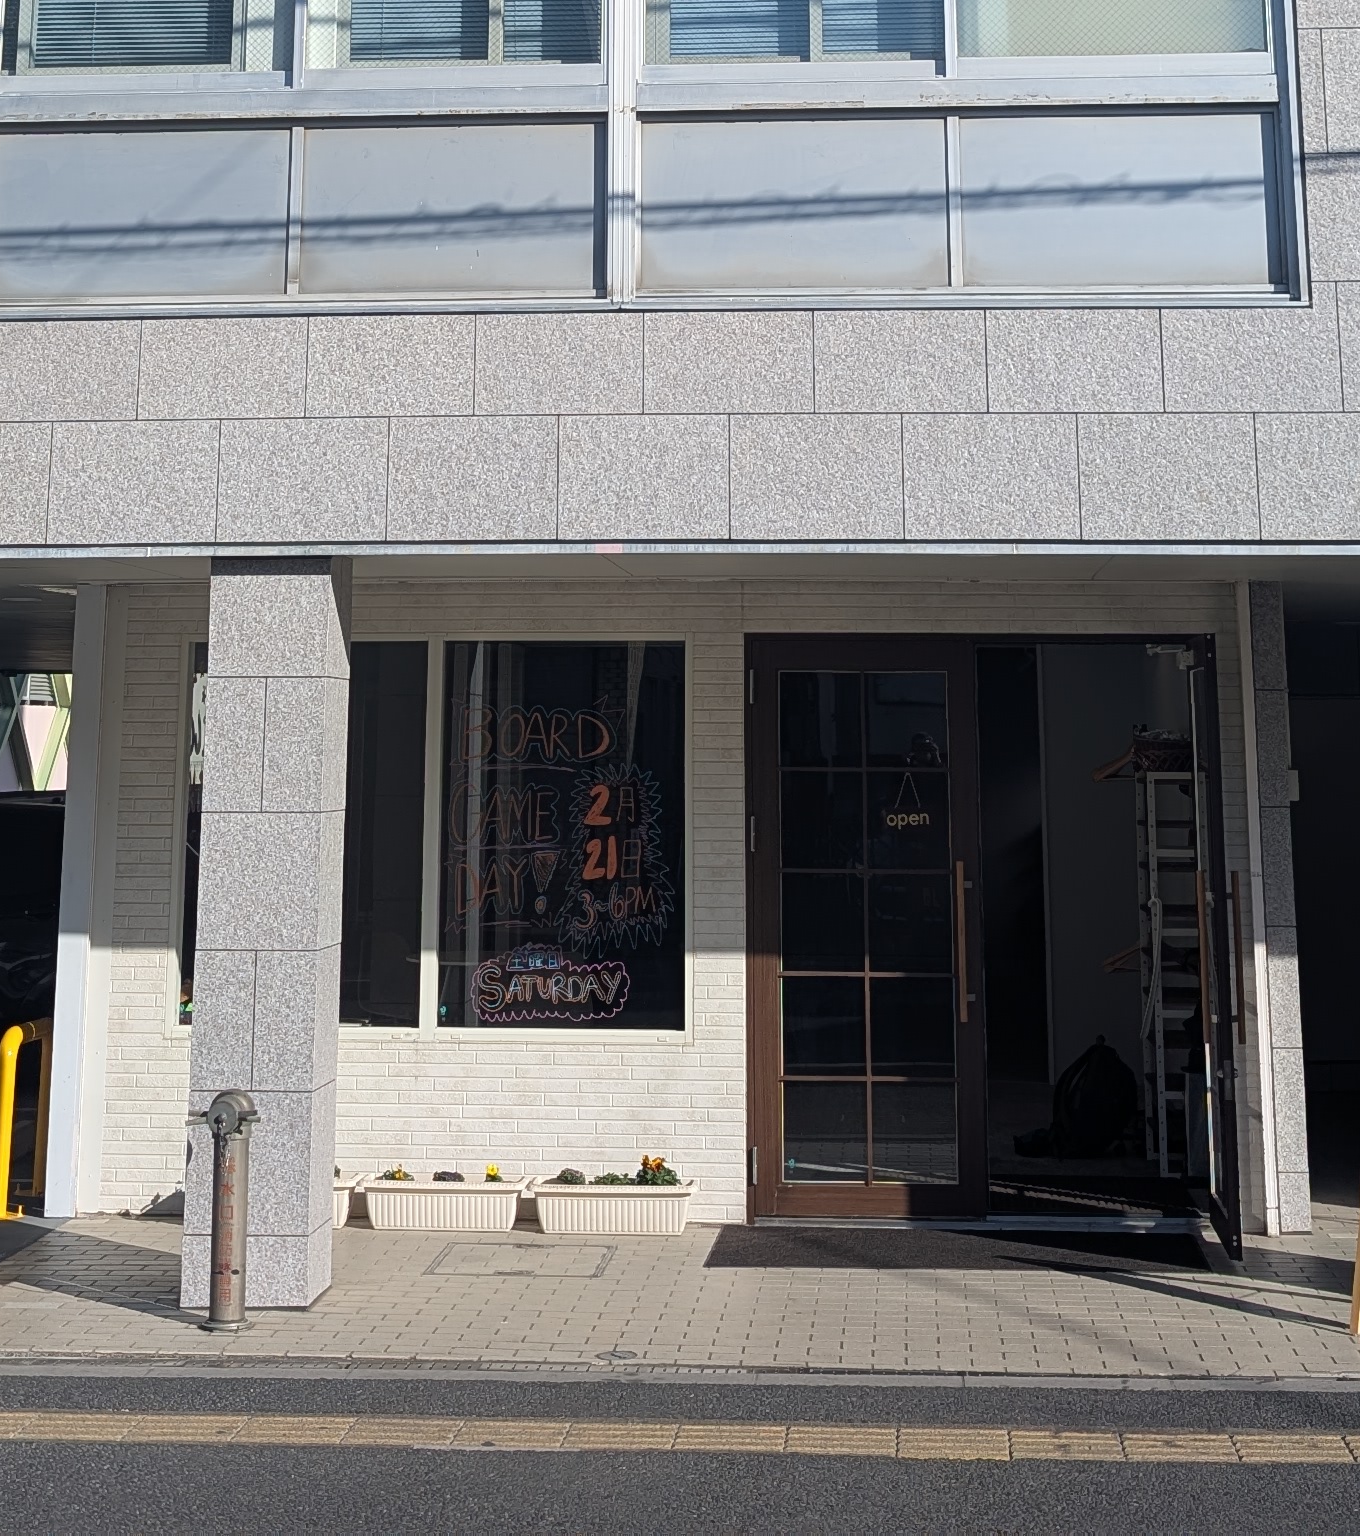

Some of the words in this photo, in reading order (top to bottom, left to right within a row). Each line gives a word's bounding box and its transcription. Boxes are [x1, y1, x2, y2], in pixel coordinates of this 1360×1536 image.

[462, 706, 611, 761] BOARD
[583, 784, 636, 827] 2月
[886, 812, 930, 830] open
[582, 835, 641, 880] 21日
